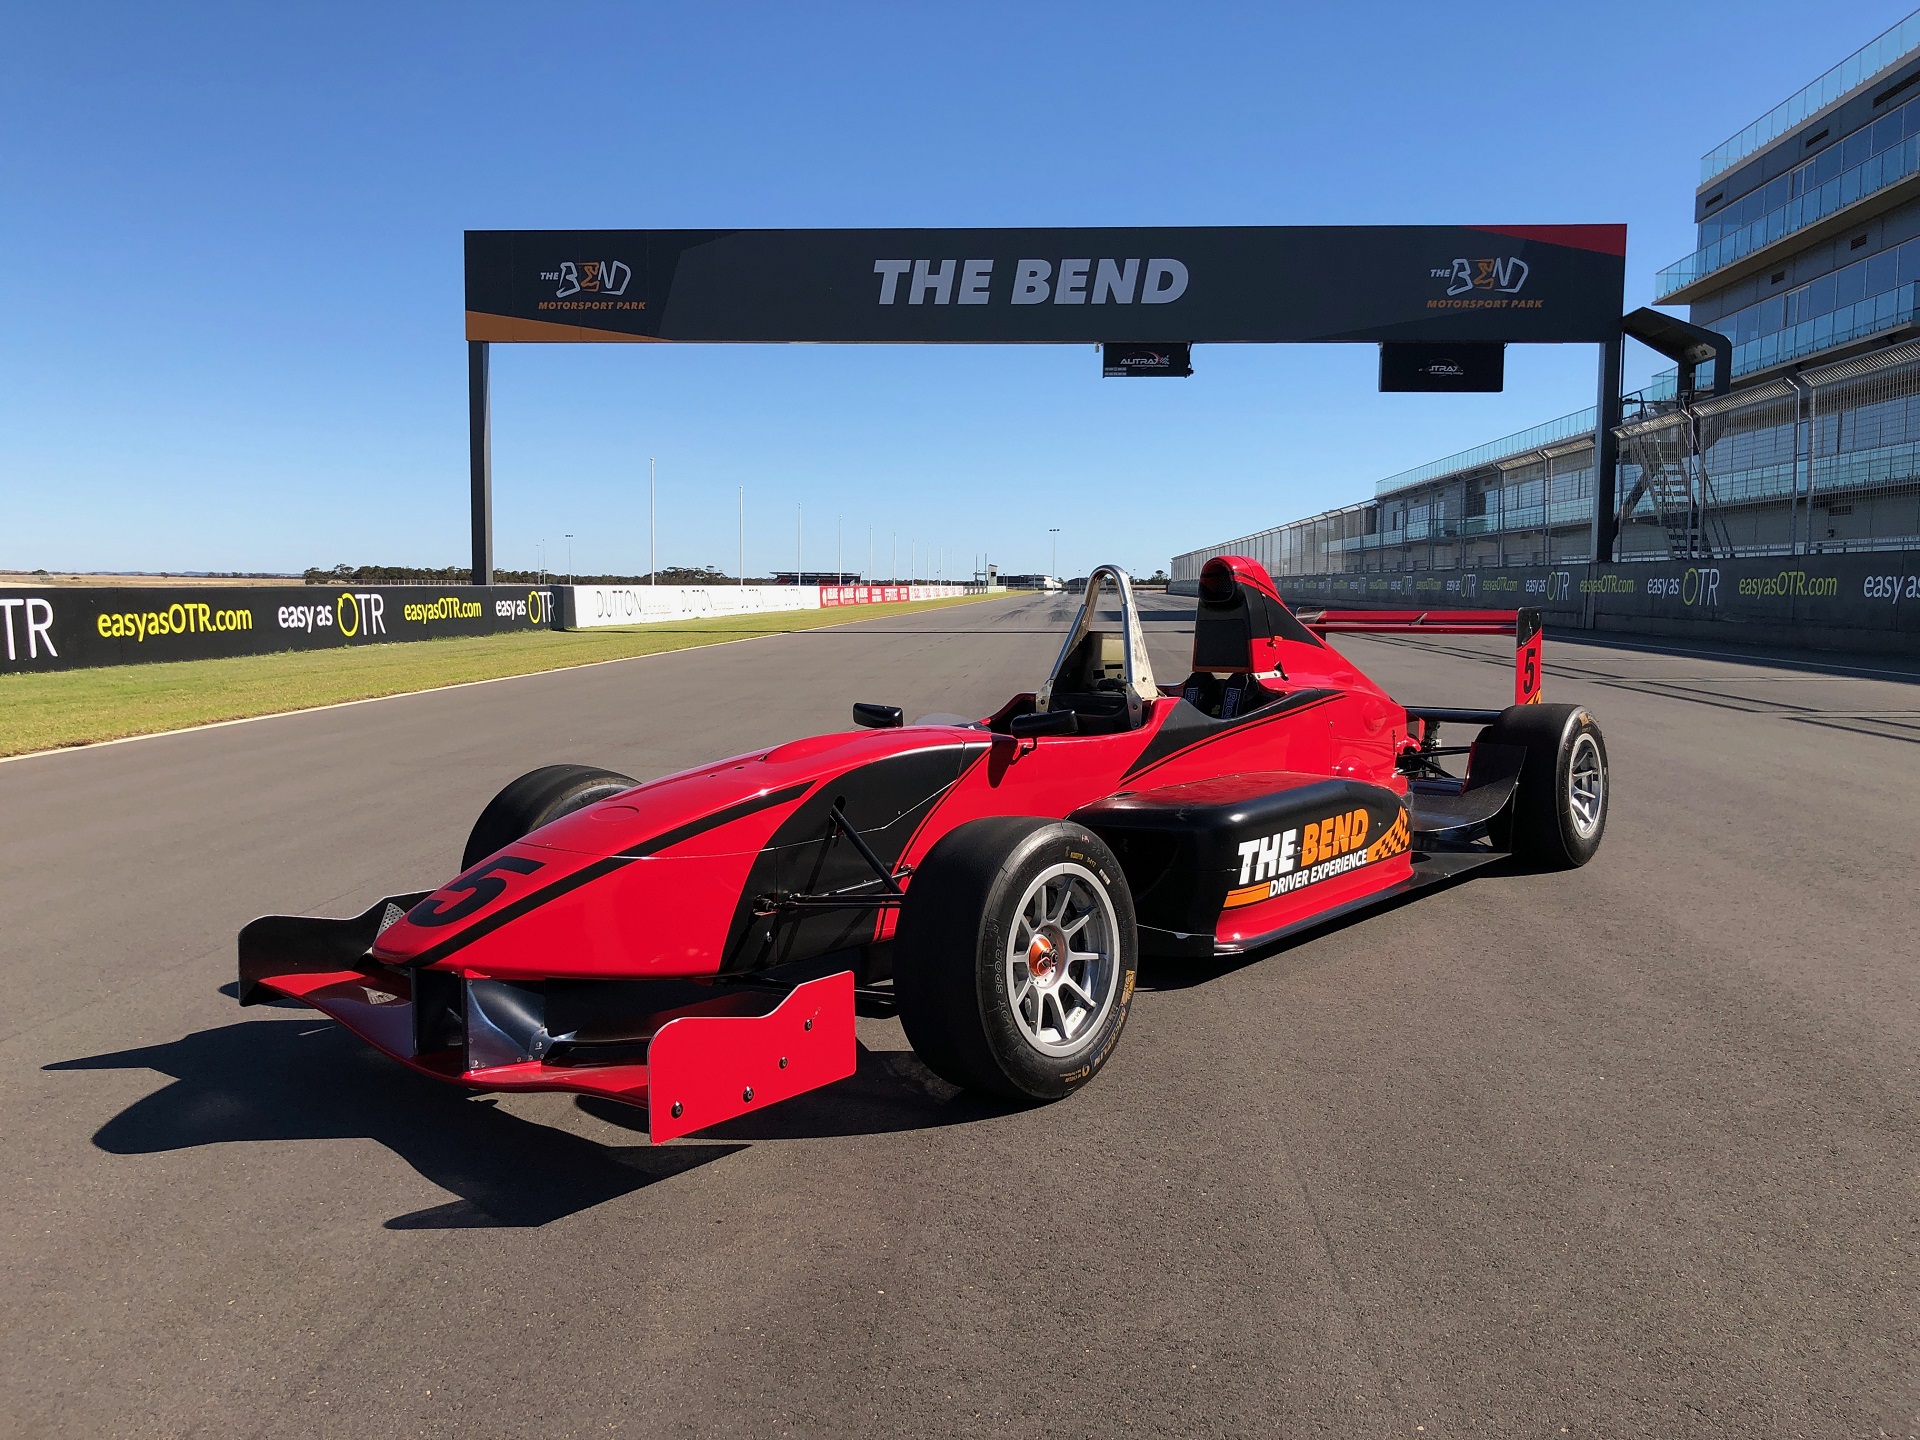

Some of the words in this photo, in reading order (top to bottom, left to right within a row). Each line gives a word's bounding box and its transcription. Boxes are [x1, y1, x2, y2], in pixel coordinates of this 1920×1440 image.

[540, 272, 559, 280] THE
[556, 260, 631, 298] BEND
[873, 259, 994, 305] THE
[1010, 258, 1189, 305] BEND
[1430, 269, 1450, 277] THE
[1446, 257, 1528, 296] BEND
[538, 301, 614, 310] MOTORSPORT
[616, 301, 646, 310] PARK
[1427, 300, 1508, 309] MOTORSPORT
[1510, 300, 1543, 309] PARK
[596, 589, 642, 618] DUTTON
[1547, 571, 1569, 600] OTR
[1579, 575, 1634, 595] easyasOTR.com
[1647, 577, 1669, 599] easy
[1682, 567, 1720, 606] OTR
[1739, 571, 1837, 599] easyasOTR.com
[1863, 575, 1904, 604] easy
[98, 603, 253, 642] easyasOTR.com
[278, 606, 314, 633] easy
[316, 605, 333, 626] as
[337, 592, 386, 637] OTR
[404, 597, 482, 625] easyasOTR.com
[496, 600, 516, 620] easy
[528, 590, 557, 624] OTR
[1523, 648, 1536, 694] 5
[1238, 829, 1297, 885] THE
[1300, 808, 1369, 867] BEND
[407, 855, 547, 927] 5
[1269, 869, 1309, 897] DRIVER
[1311, 849, 1368, 883] EXPERIENCE
